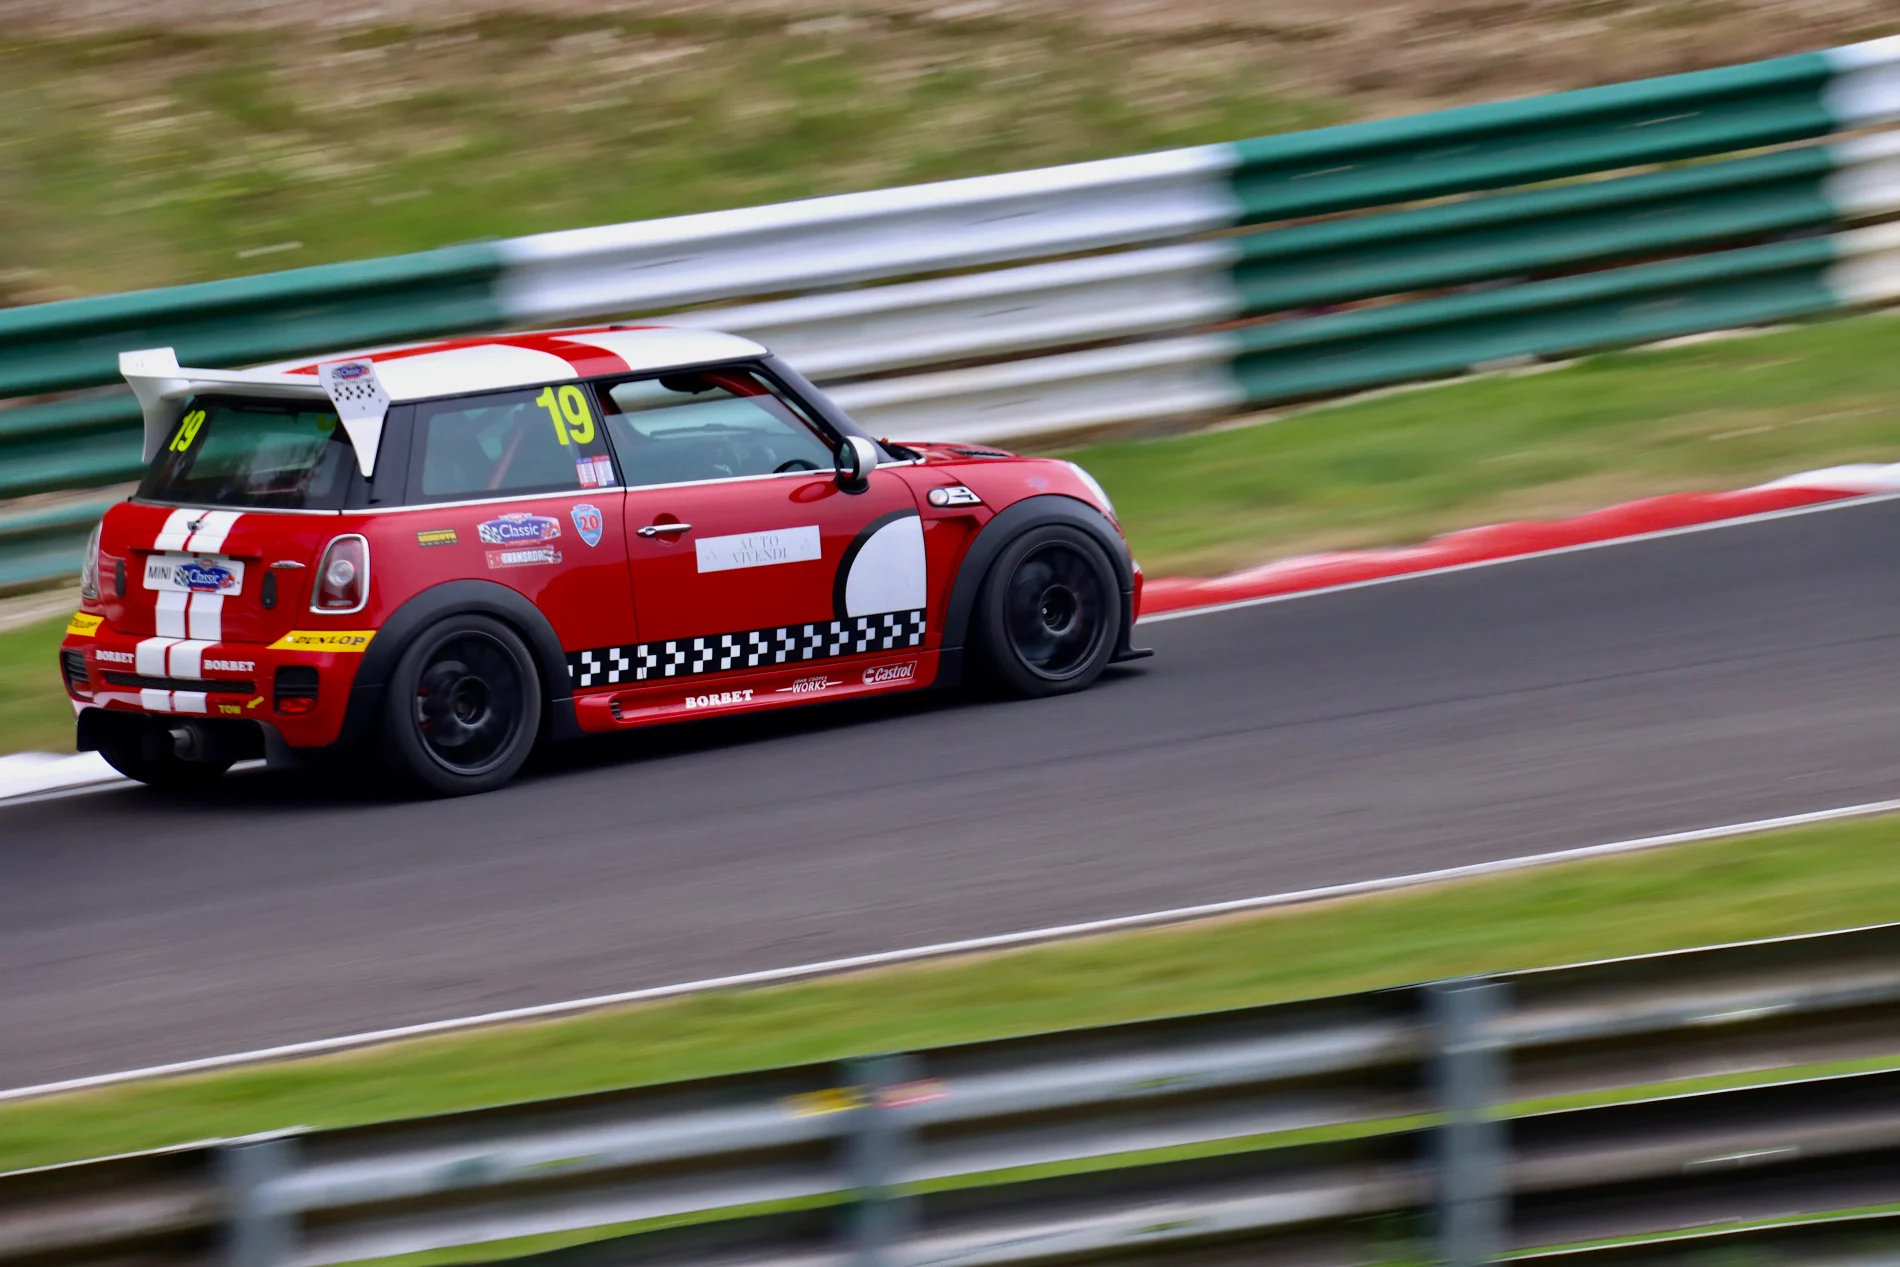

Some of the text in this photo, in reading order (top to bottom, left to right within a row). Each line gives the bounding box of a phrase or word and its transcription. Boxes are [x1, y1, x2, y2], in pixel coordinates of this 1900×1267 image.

[536, 385, 595, 446] 19
[169, 410, 206, 452] 19
[578, 514, 600, 531] 20
[499, 523, 540, 538] Classic
[741, 535, 779, 550] AUTO
[733, 547, 787, 563] VIVENDI
[148, 565, 219, 585] MINI Classic
[294, 635, 366, 646] DUNLOP
[95, 649, 135, 664] BORBET
[203, 659, 256, 672] BORBET
[874, 663, 913, 682] Castrol
[792, 680, 828, 693] WORKS
[685, 689, 754, 709] BORBET
[218, 704, 242, 715] TOW
